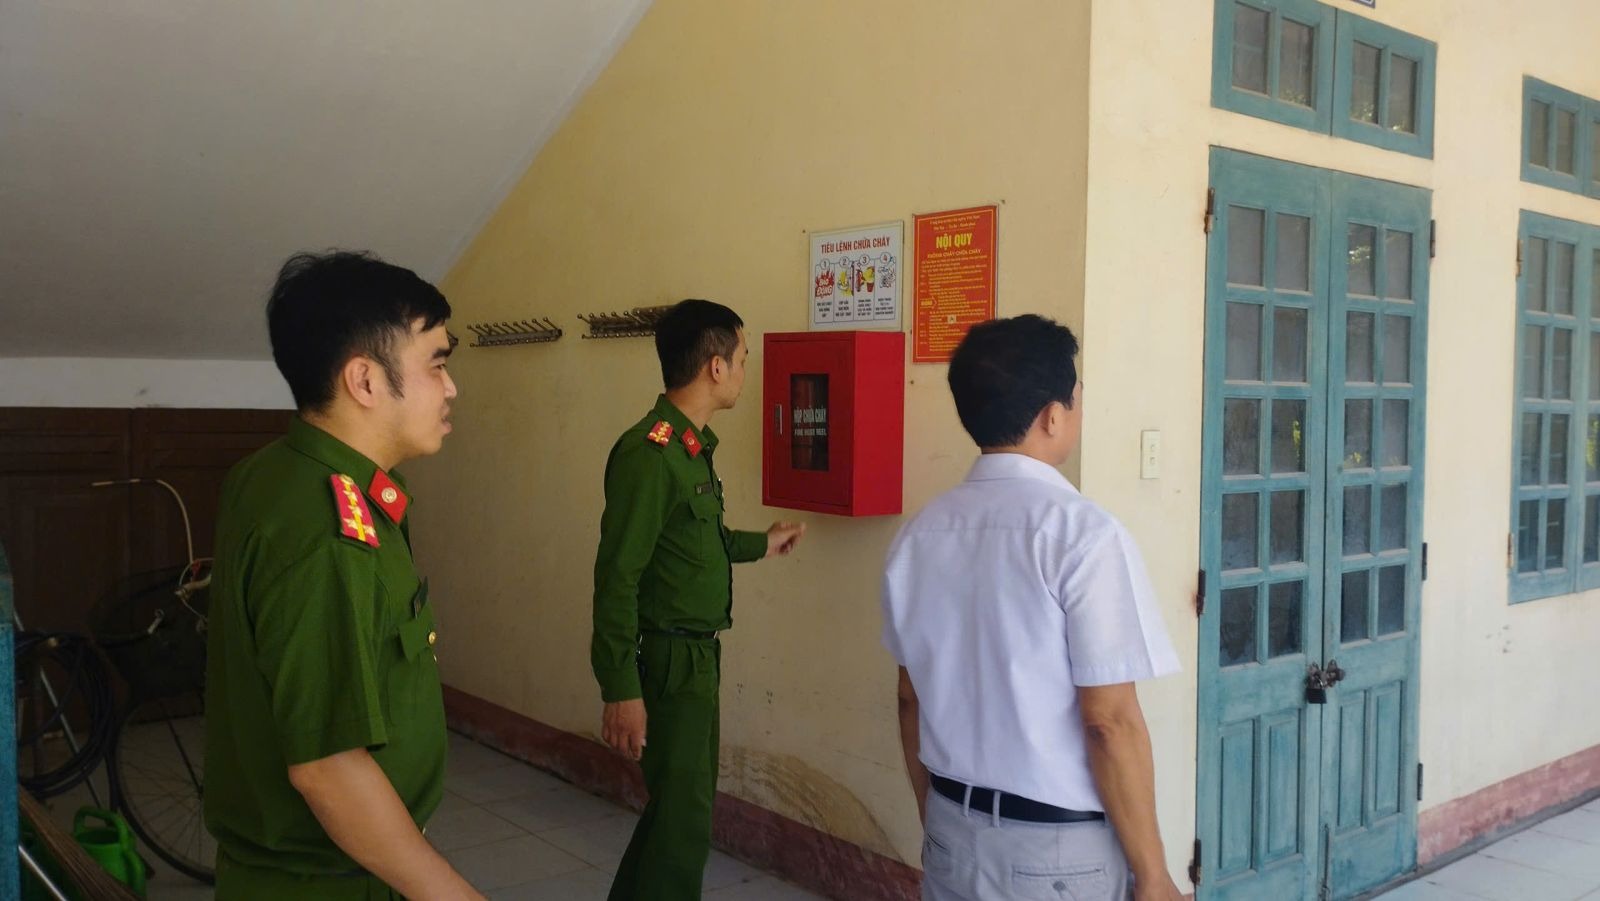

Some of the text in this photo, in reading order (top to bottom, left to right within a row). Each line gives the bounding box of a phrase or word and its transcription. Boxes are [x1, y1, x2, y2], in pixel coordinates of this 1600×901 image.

[836, 240, 851, 254] LỆNH
[873, 236, 890, 247] CHÁY
[936, 233, 973, 250] NỘI QUY
